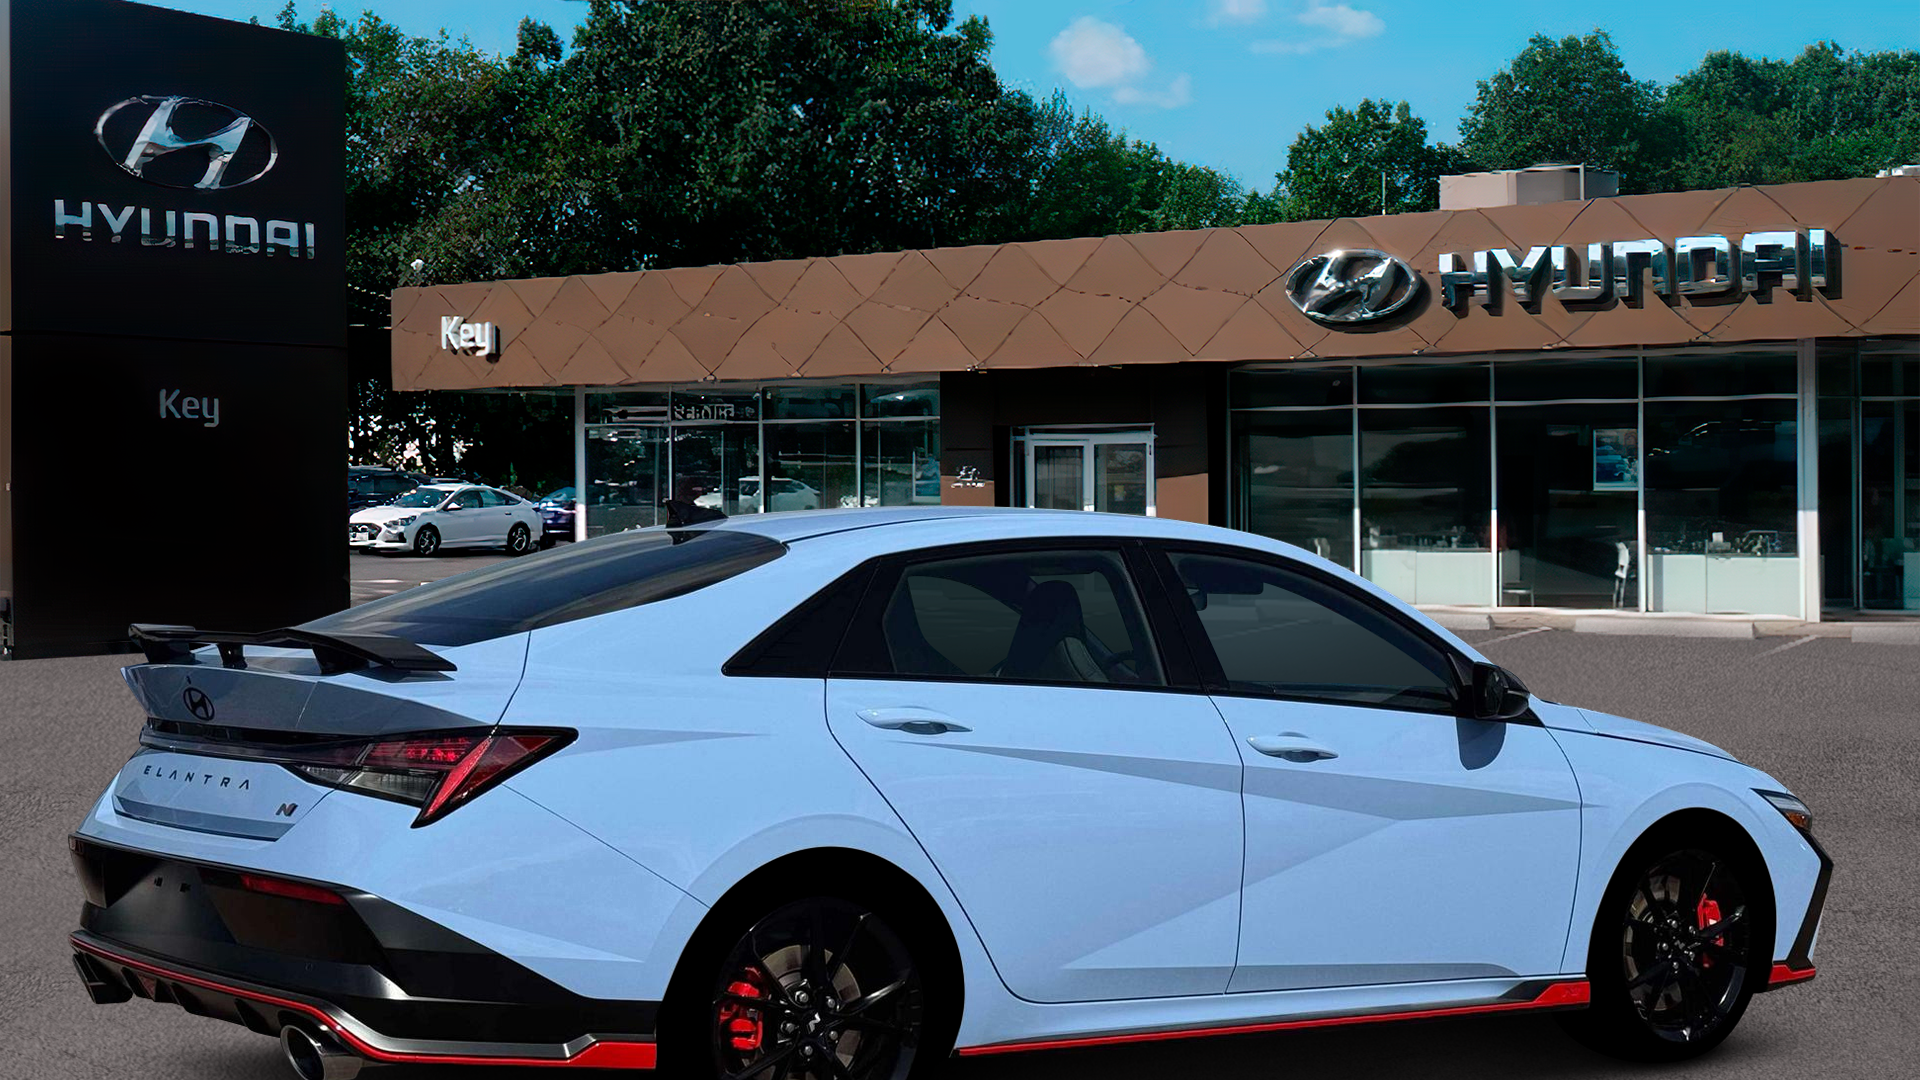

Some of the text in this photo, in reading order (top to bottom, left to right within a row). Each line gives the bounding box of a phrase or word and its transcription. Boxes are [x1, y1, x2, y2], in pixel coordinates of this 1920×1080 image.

[54, 199, 315, 260] HYUNDAI
[1438, 228, 1838, 309] HYUNDAI
[441, 315, 494, 357] Key
[158, 388, 220, 428] Key
[143, 765, 251, 791] ELANTRA
